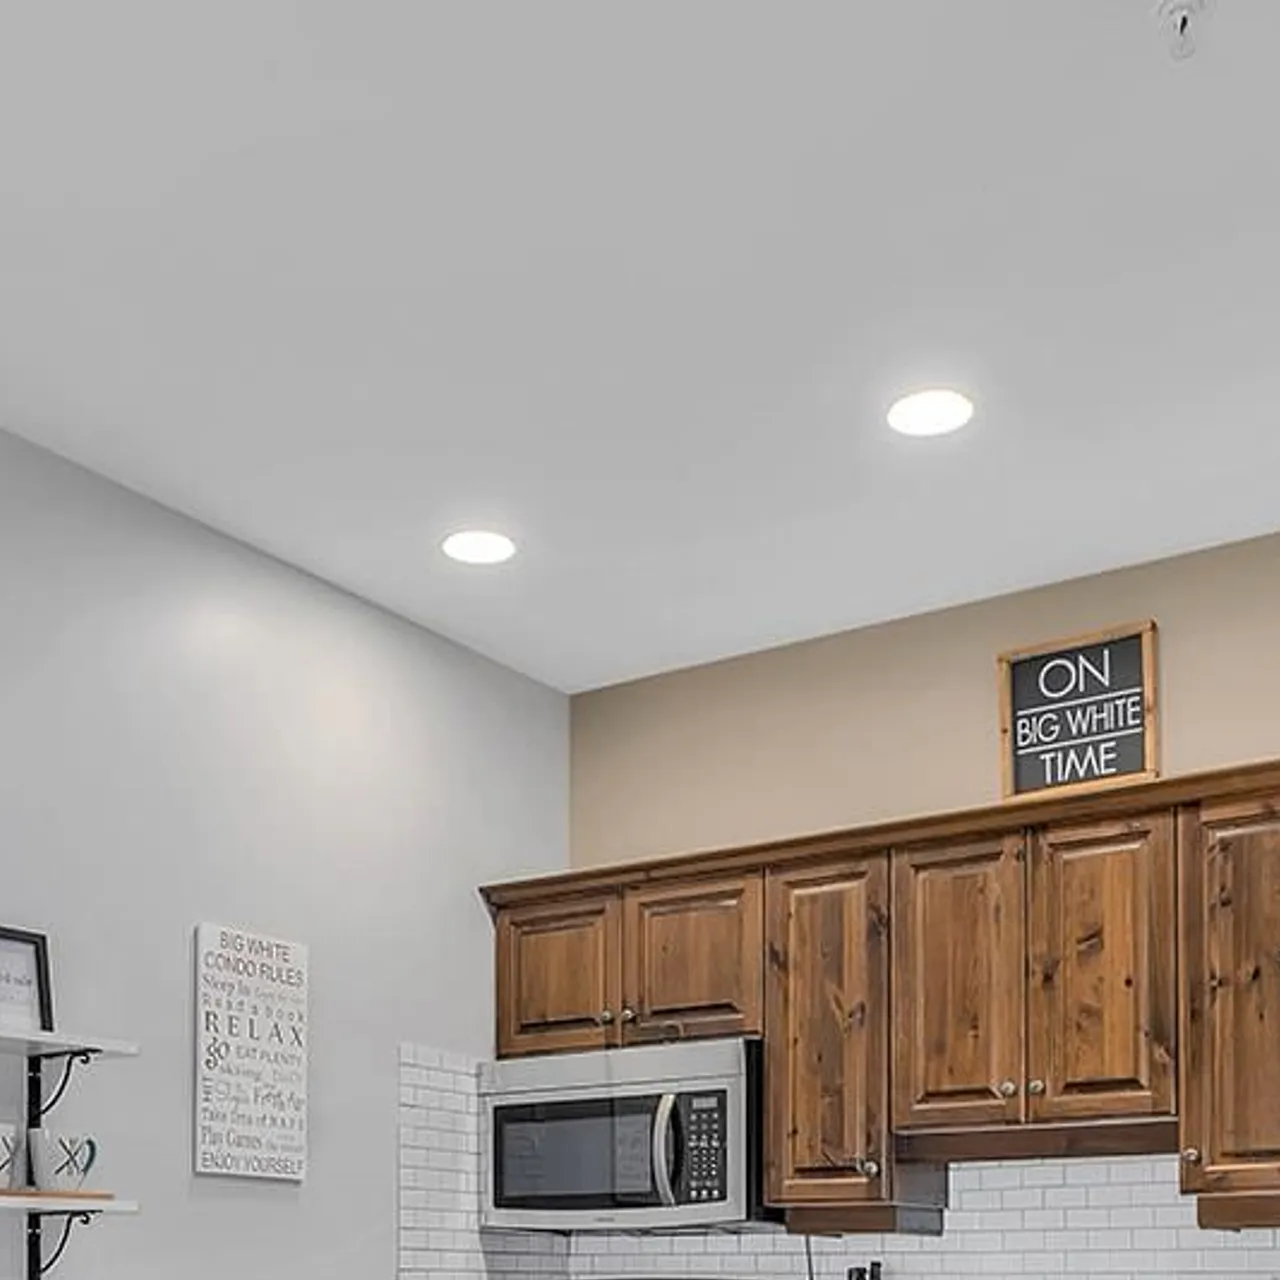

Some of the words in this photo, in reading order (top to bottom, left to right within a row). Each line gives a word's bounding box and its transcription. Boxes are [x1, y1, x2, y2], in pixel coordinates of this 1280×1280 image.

[1038, 649, 1110, 698] ON
[1017, 713, 1060, 746] BIG
[1066, 695, 1141, 736] WHITE
[1039, 741, 1117, 784] TIME
[220, 930, 244, 952] BIG
[246, 936, 291, 963] WHITE
[204, 950, 258, 978] CONDO
[260, 962, 305, 988] RULES
[205, 1010, 304, 1048] RELAX
[201, 1151, 242, 1170] ENJOY
[243, 1155, 304, 1176] YOURSELF
